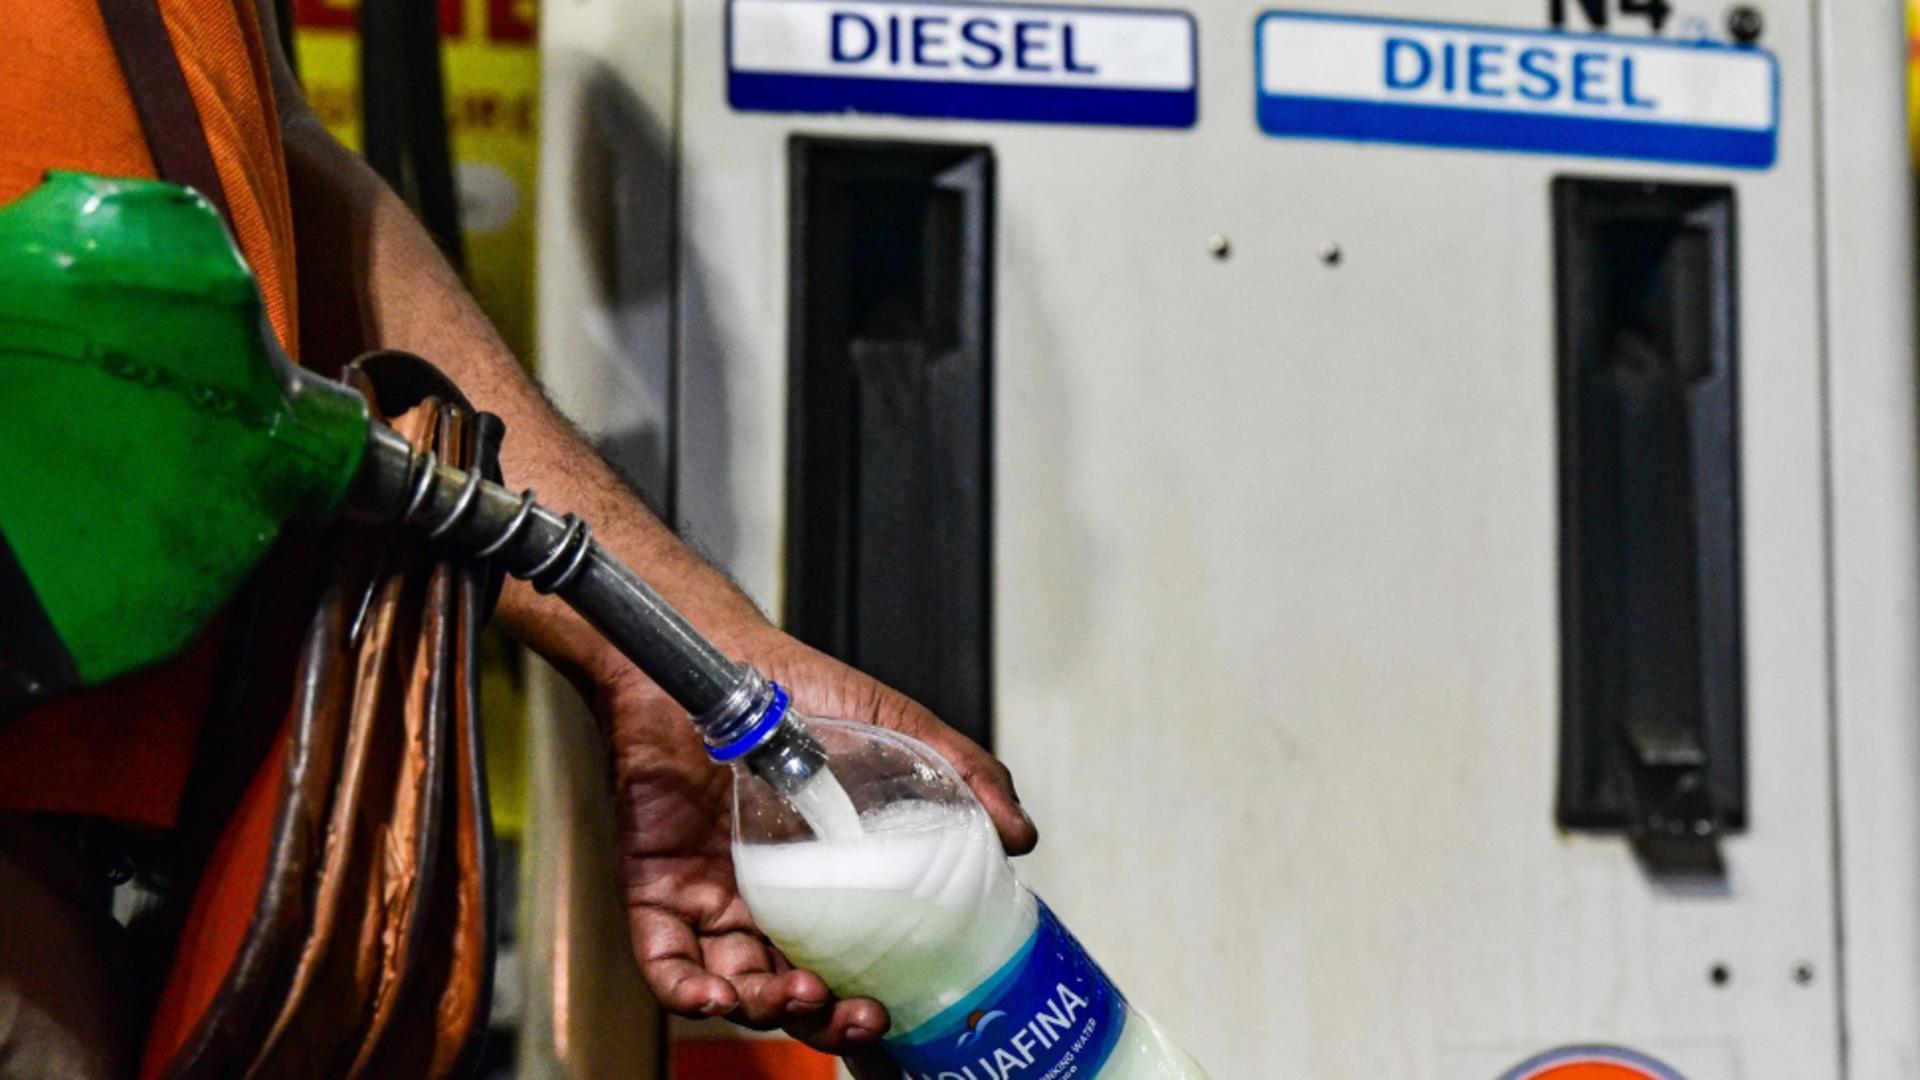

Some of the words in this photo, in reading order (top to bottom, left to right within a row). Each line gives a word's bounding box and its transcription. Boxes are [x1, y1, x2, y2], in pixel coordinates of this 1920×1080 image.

[830, 12, 1097, 74] DIESEL
[1384, 37, 1658, 109] DIESEL
[921, 982, 1088, 1080] UAFINA
[1071, 1018, 1096, 1053] WATER
